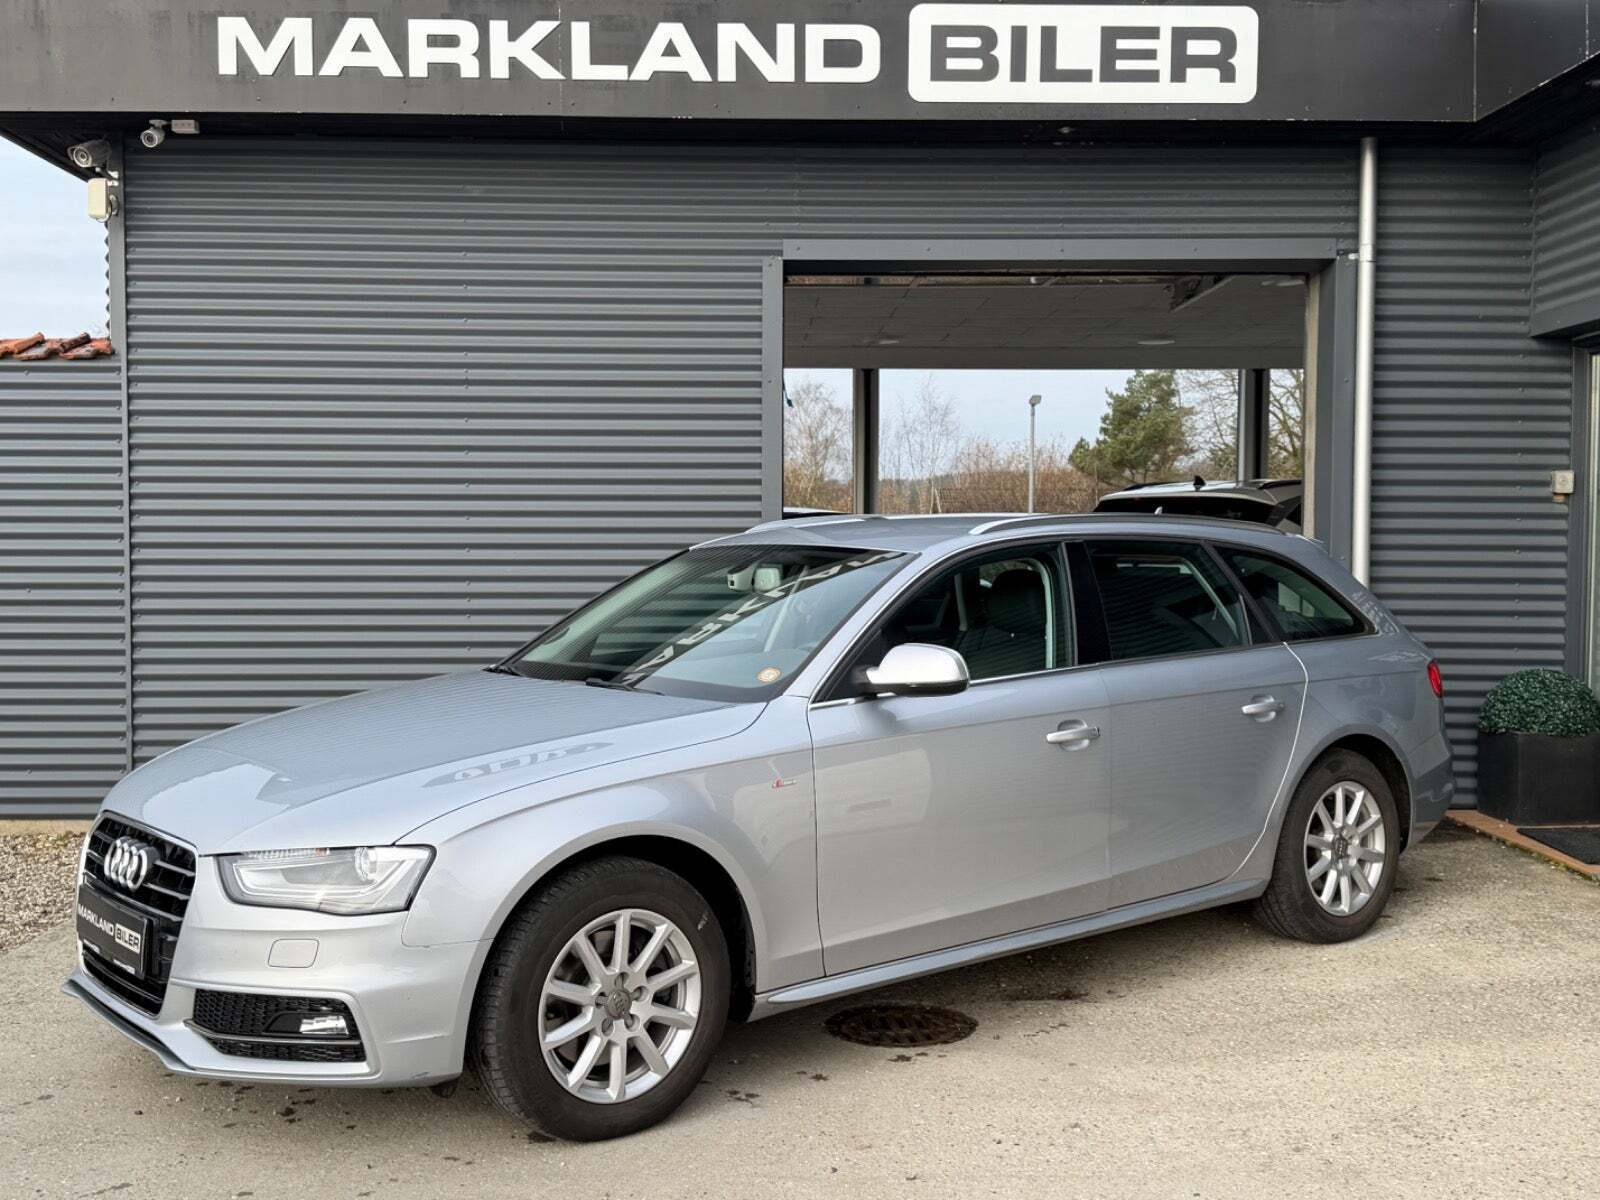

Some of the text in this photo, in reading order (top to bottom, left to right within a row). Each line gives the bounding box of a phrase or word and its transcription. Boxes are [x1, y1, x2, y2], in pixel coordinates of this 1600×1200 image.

[216, 16, 1238, 84] MARKLAND BILER
[78, 903, 114, 936] MARKLAND
[116, 926, 140, 949] BILER
